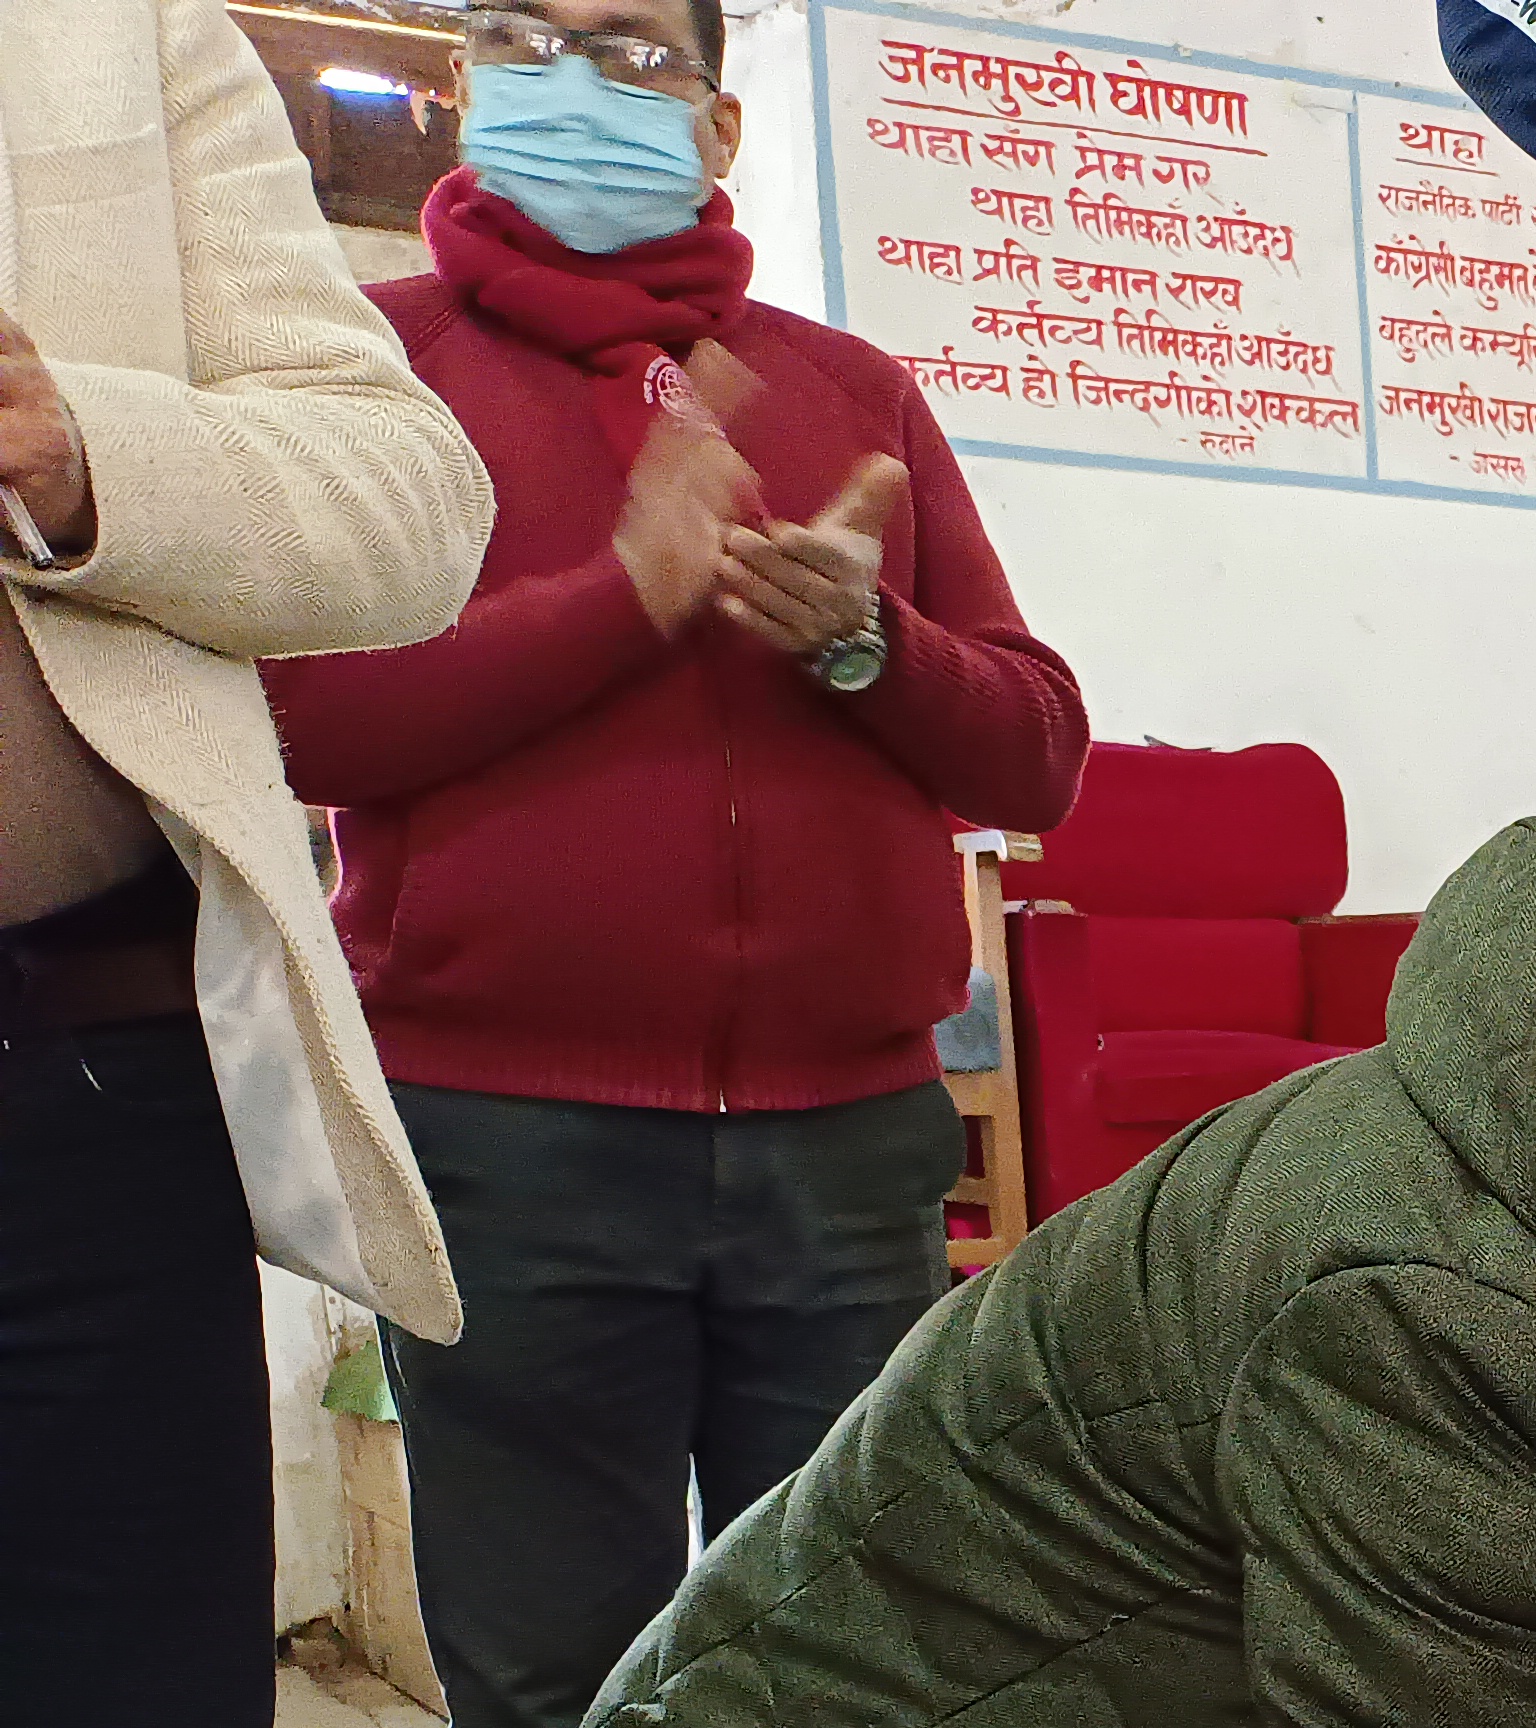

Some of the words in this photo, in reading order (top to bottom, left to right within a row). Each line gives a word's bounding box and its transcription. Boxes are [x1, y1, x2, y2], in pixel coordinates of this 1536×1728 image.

[1103, 60, 1249, 137] घोषणा
[866, 117, 972, 167] थाहा
[1074, 131, 1145, 188] प्रेम
[1399, 122, 1487, 166] थाहा
[971, 187, 1053, 235] थाहा
[877, 235, 962, 284] थाहा
[973, 238, 1040, 287] प्रति
[1053, 257, 1160, 306] इमान
[1020, 353, 1060, 408] हो
